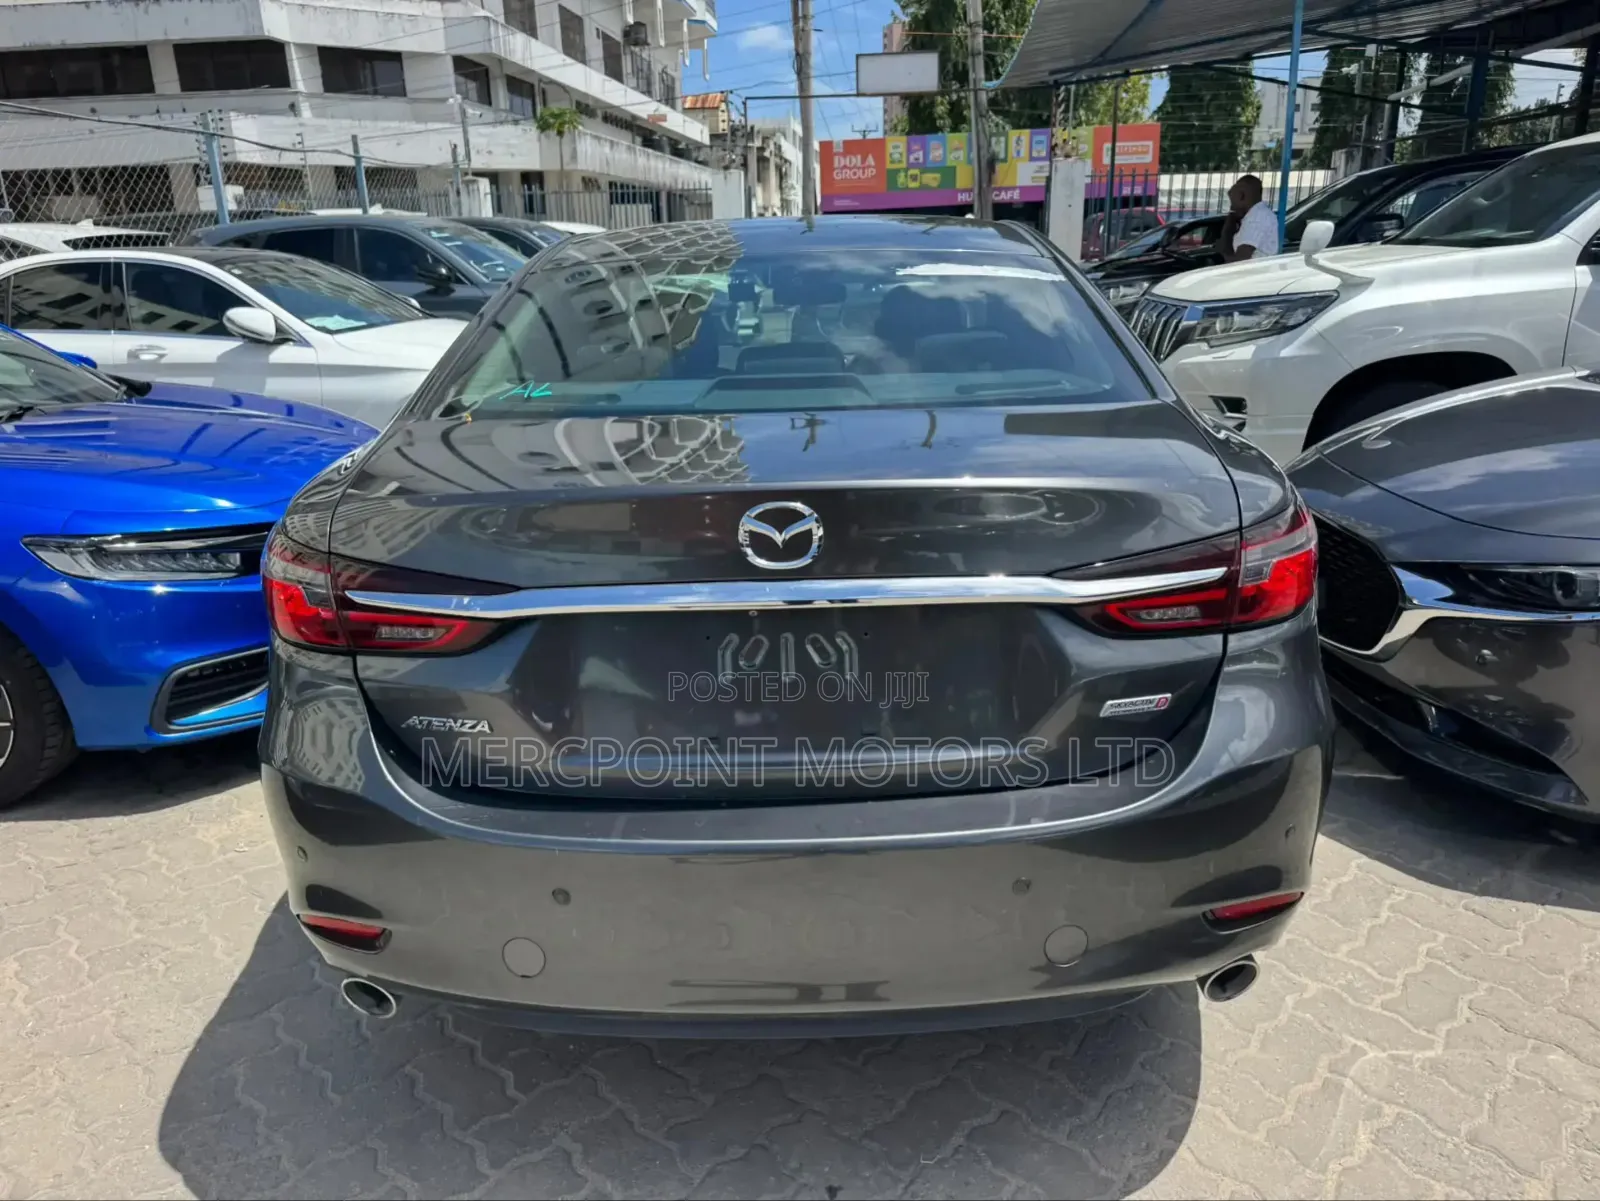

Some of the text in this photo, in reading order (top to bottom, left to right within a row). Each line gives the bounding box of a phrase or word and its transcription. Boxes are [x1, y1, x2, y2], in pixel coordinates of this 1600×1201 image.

[833, 154, 875, 167] DOLA
[833, 168, 877, 179] GROUP
[992, 188, 1020, 200] CAFÉ
[401, 715, 494, 734] ATENZA
